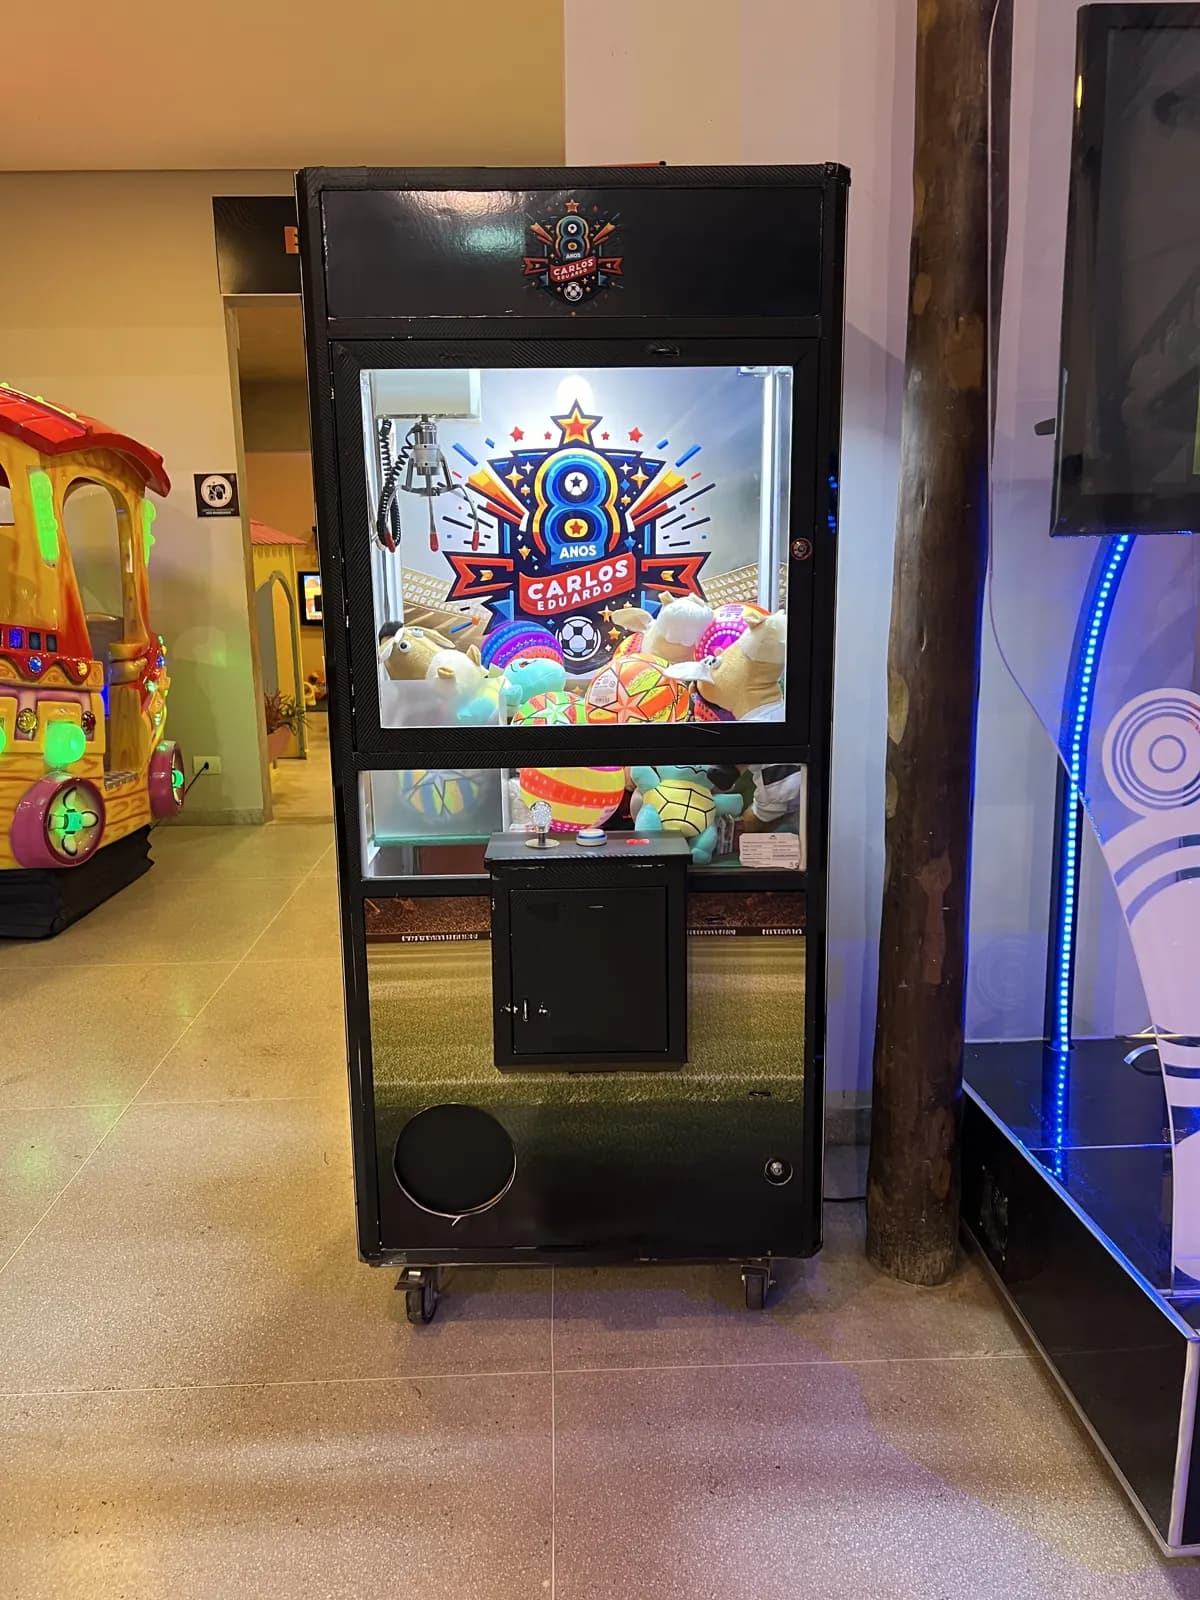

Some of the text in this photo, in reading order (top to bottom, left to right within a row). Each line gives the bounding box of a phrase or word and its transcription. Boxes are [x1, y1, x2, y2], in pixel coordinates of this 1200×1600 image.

[557, 215, 589, 256] 8
[553, 259, 594, 276] CARLOS
[540, 450, 612, 548] 8
[559, 544, 597, 560] ANOS
[527, 559, 629, 600] CARLOS
[537, 582, 613, 611] EDUARDO
